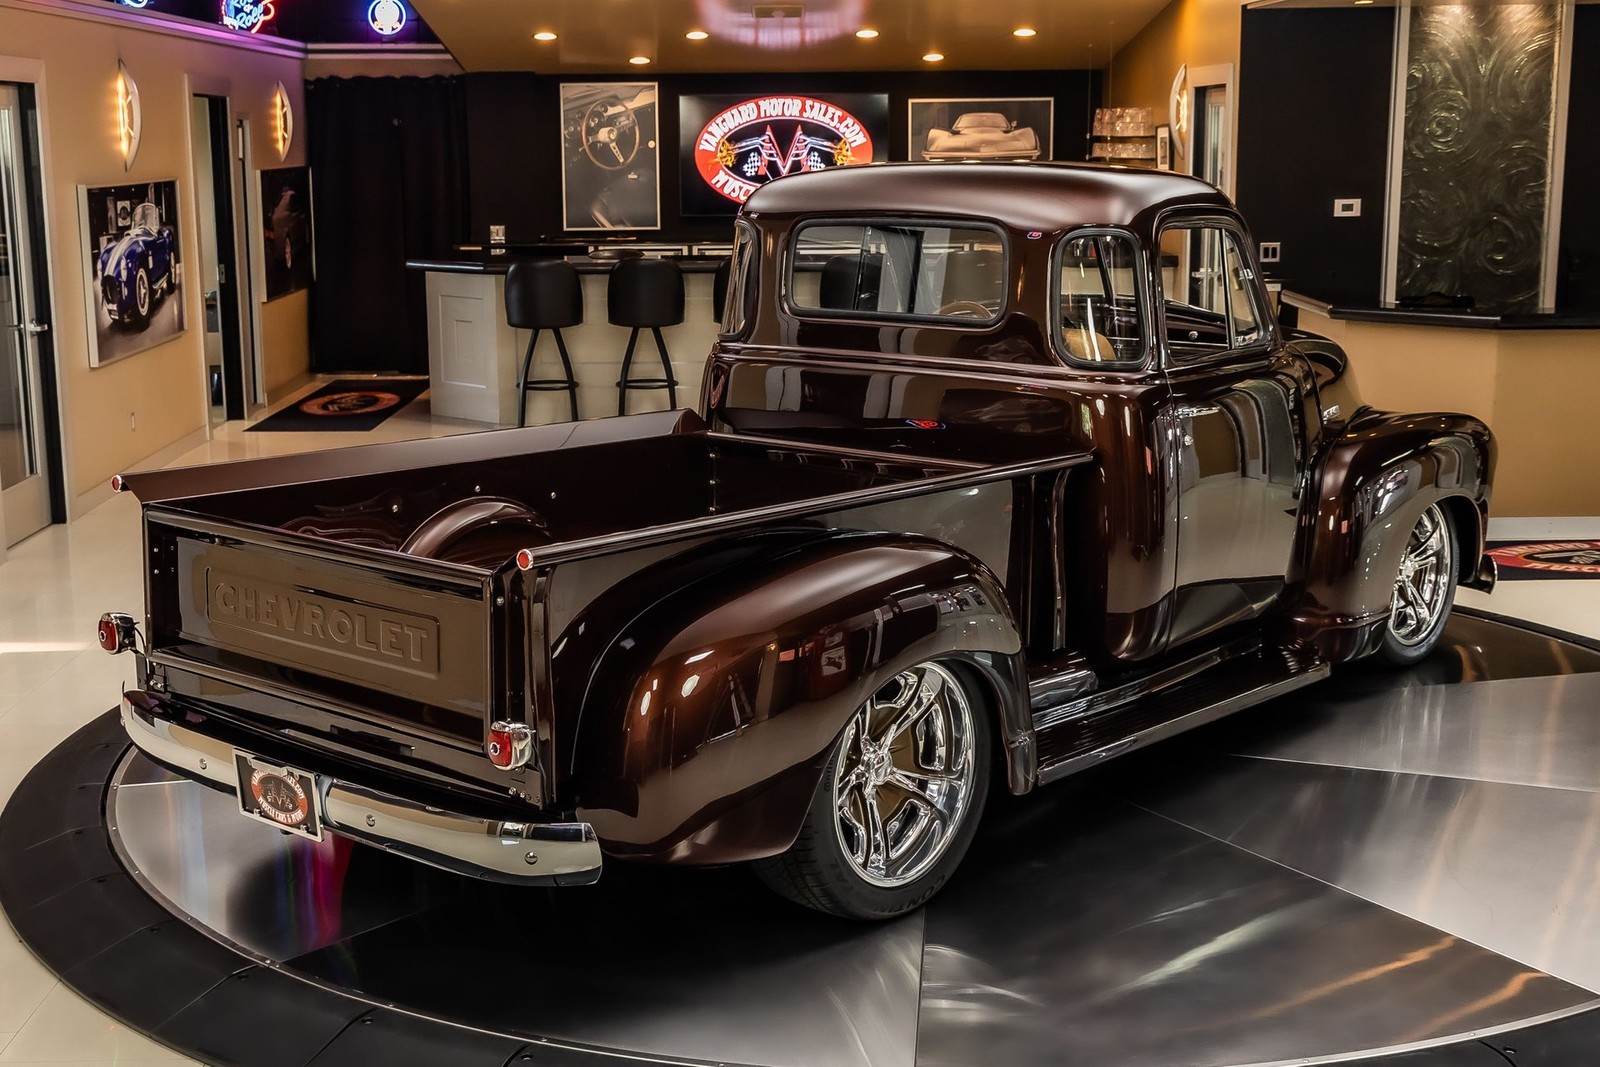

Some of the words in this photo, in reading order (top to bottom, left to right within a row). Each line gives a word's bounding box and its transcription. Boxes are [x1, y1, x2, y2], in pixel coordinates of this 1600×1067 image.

[236, 3, 264, 29] Roll
[699, 103, 758, 152] VANGUARD
[759, 98, 802, 118] MOTOR
[803, 99, 867, 147] SALES.COM
[214, 582, 428, 663] CHEVROLET
